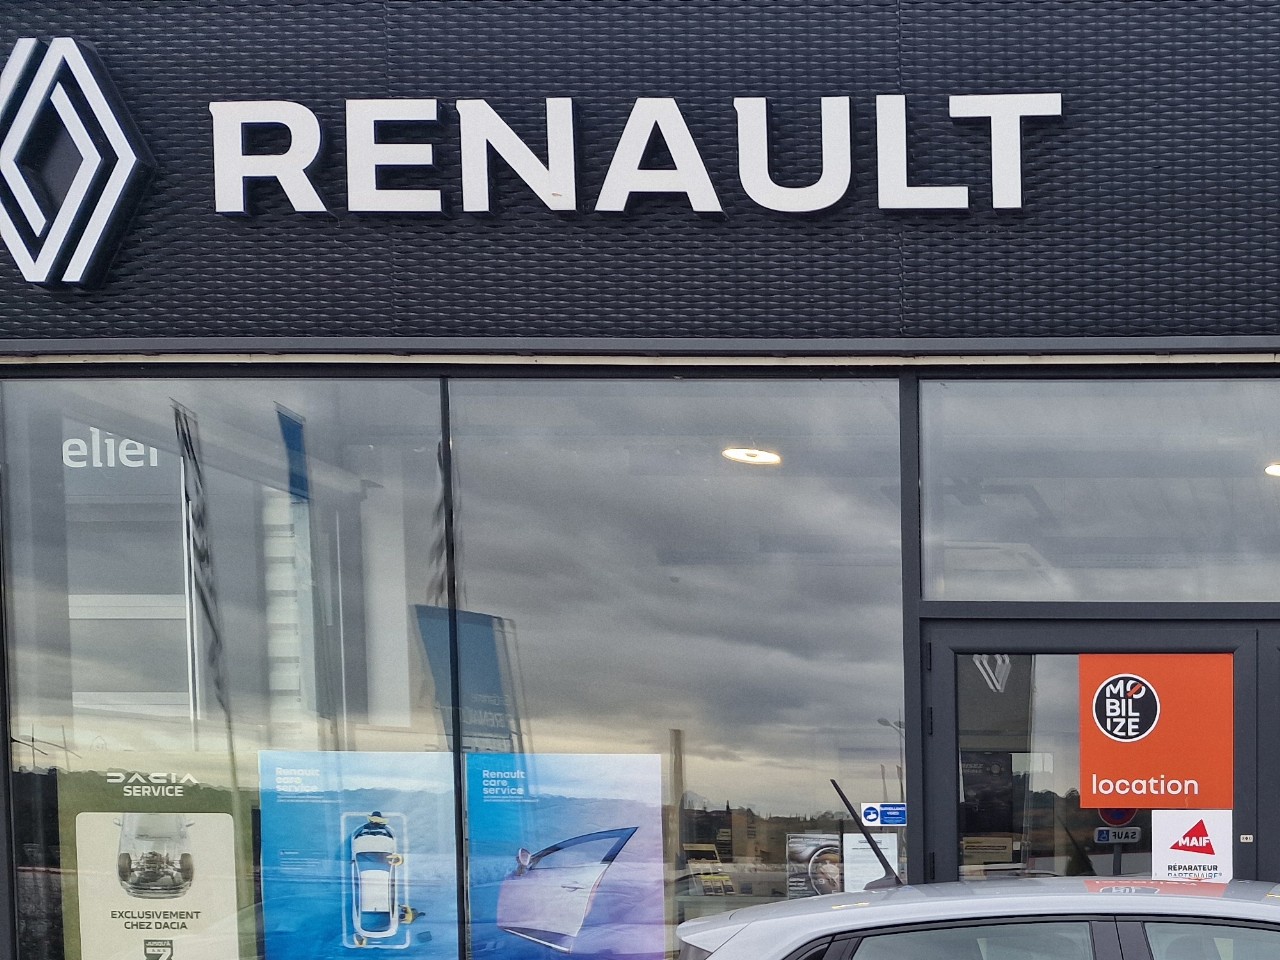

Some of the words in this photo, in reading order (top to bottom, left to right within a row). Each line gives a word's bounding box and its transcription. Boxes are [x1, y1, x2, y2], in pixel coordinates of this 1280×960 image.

[208, 92, 1062, 215] RENAULT
[106, 772, 199, 784] DACIA
[482, 769, 525, 779] Renault
[482, 779, 508, 787] care
[1092, 773, 1199, 795] location
[123, 785, 184, 797] SERVICE
[482, 786, 524, 795] service
[1178, 836, 1211, 847] MAIF
[1167, 862, 1218, 871] RÉPARATEUR
[110, 910, 201, 920] EXCLUSIVEMENT
[124, 921, 153, 930] CHEZ
[155, 921, 188, 930] DACIA
